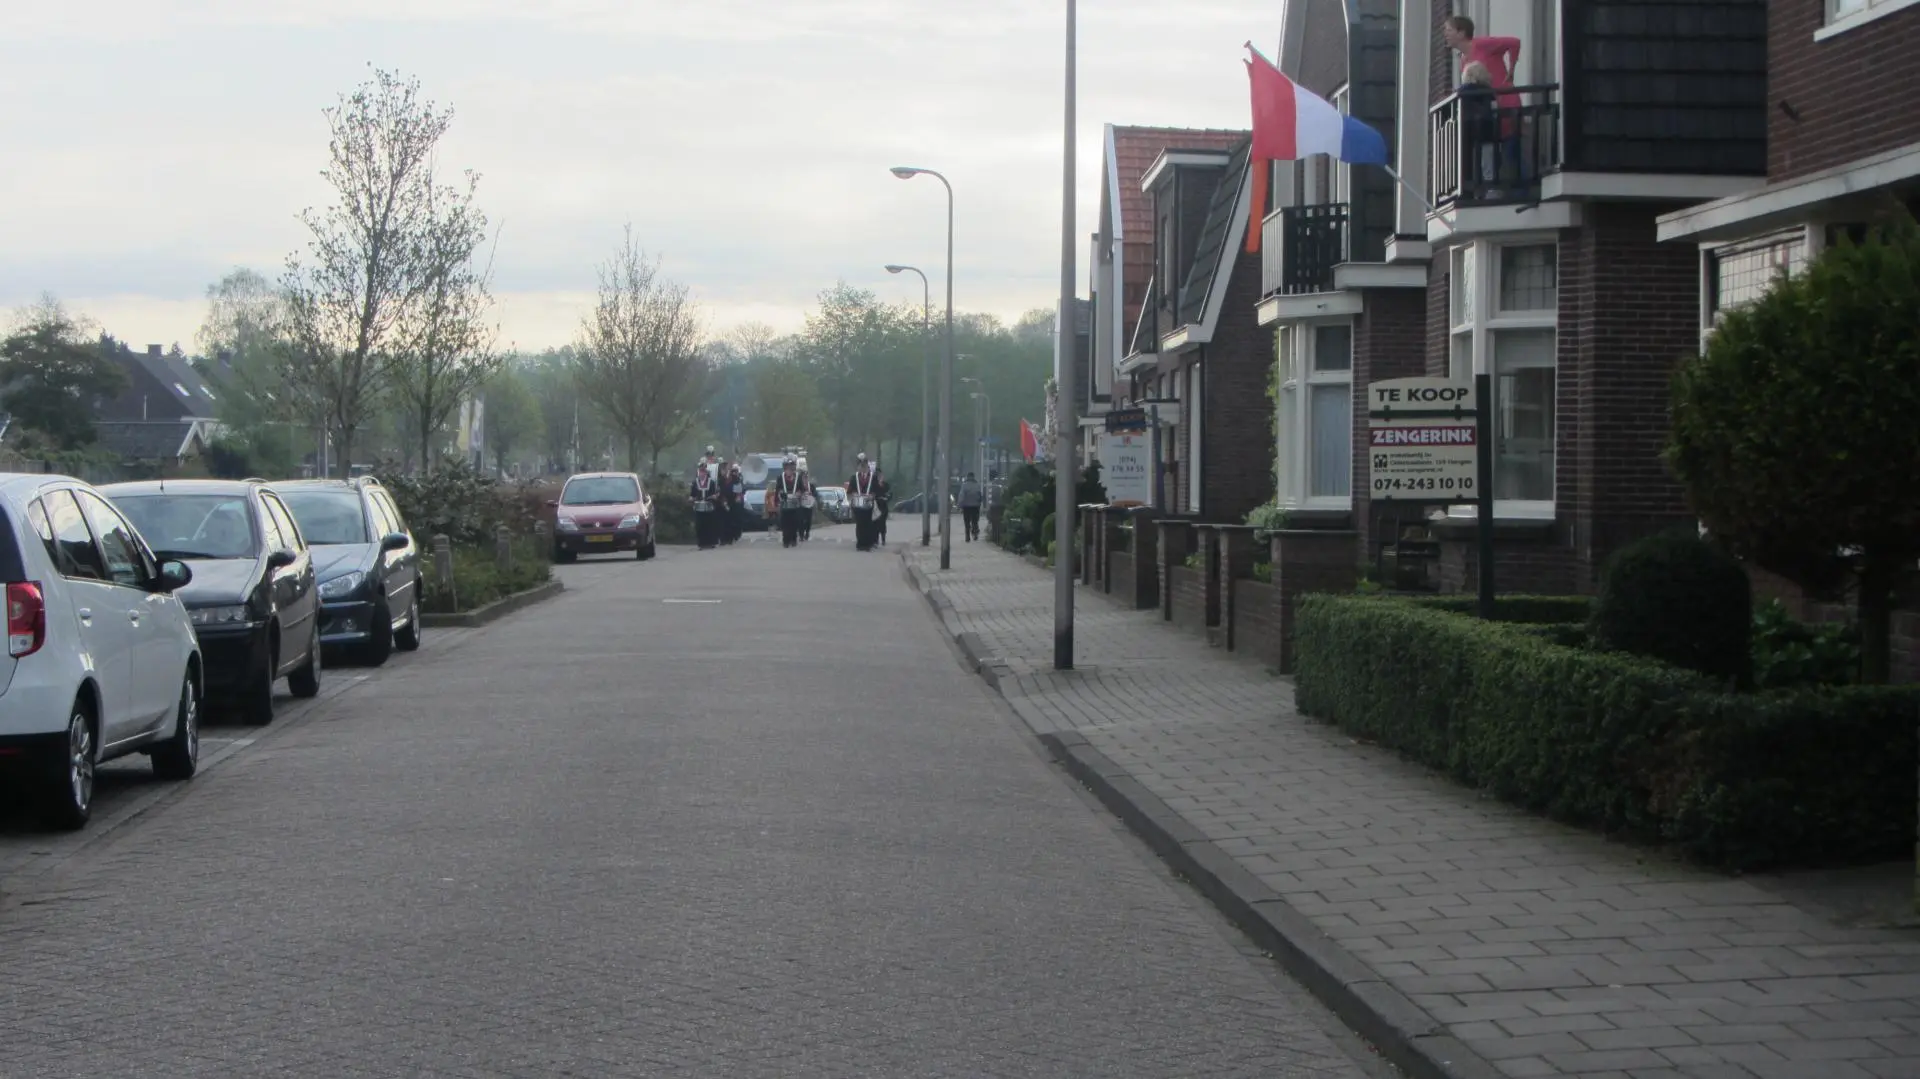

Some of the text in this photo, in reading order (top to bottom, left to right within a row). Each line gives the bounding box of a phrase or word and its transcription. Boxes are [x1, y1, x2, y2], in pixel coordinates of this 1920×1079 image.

[1375, 388, 1469, 402] TE KOOP
[1373, 429, 1473, 443] ZENGERINK
[1374, 477, 1473, 490] 074-243 10 10
